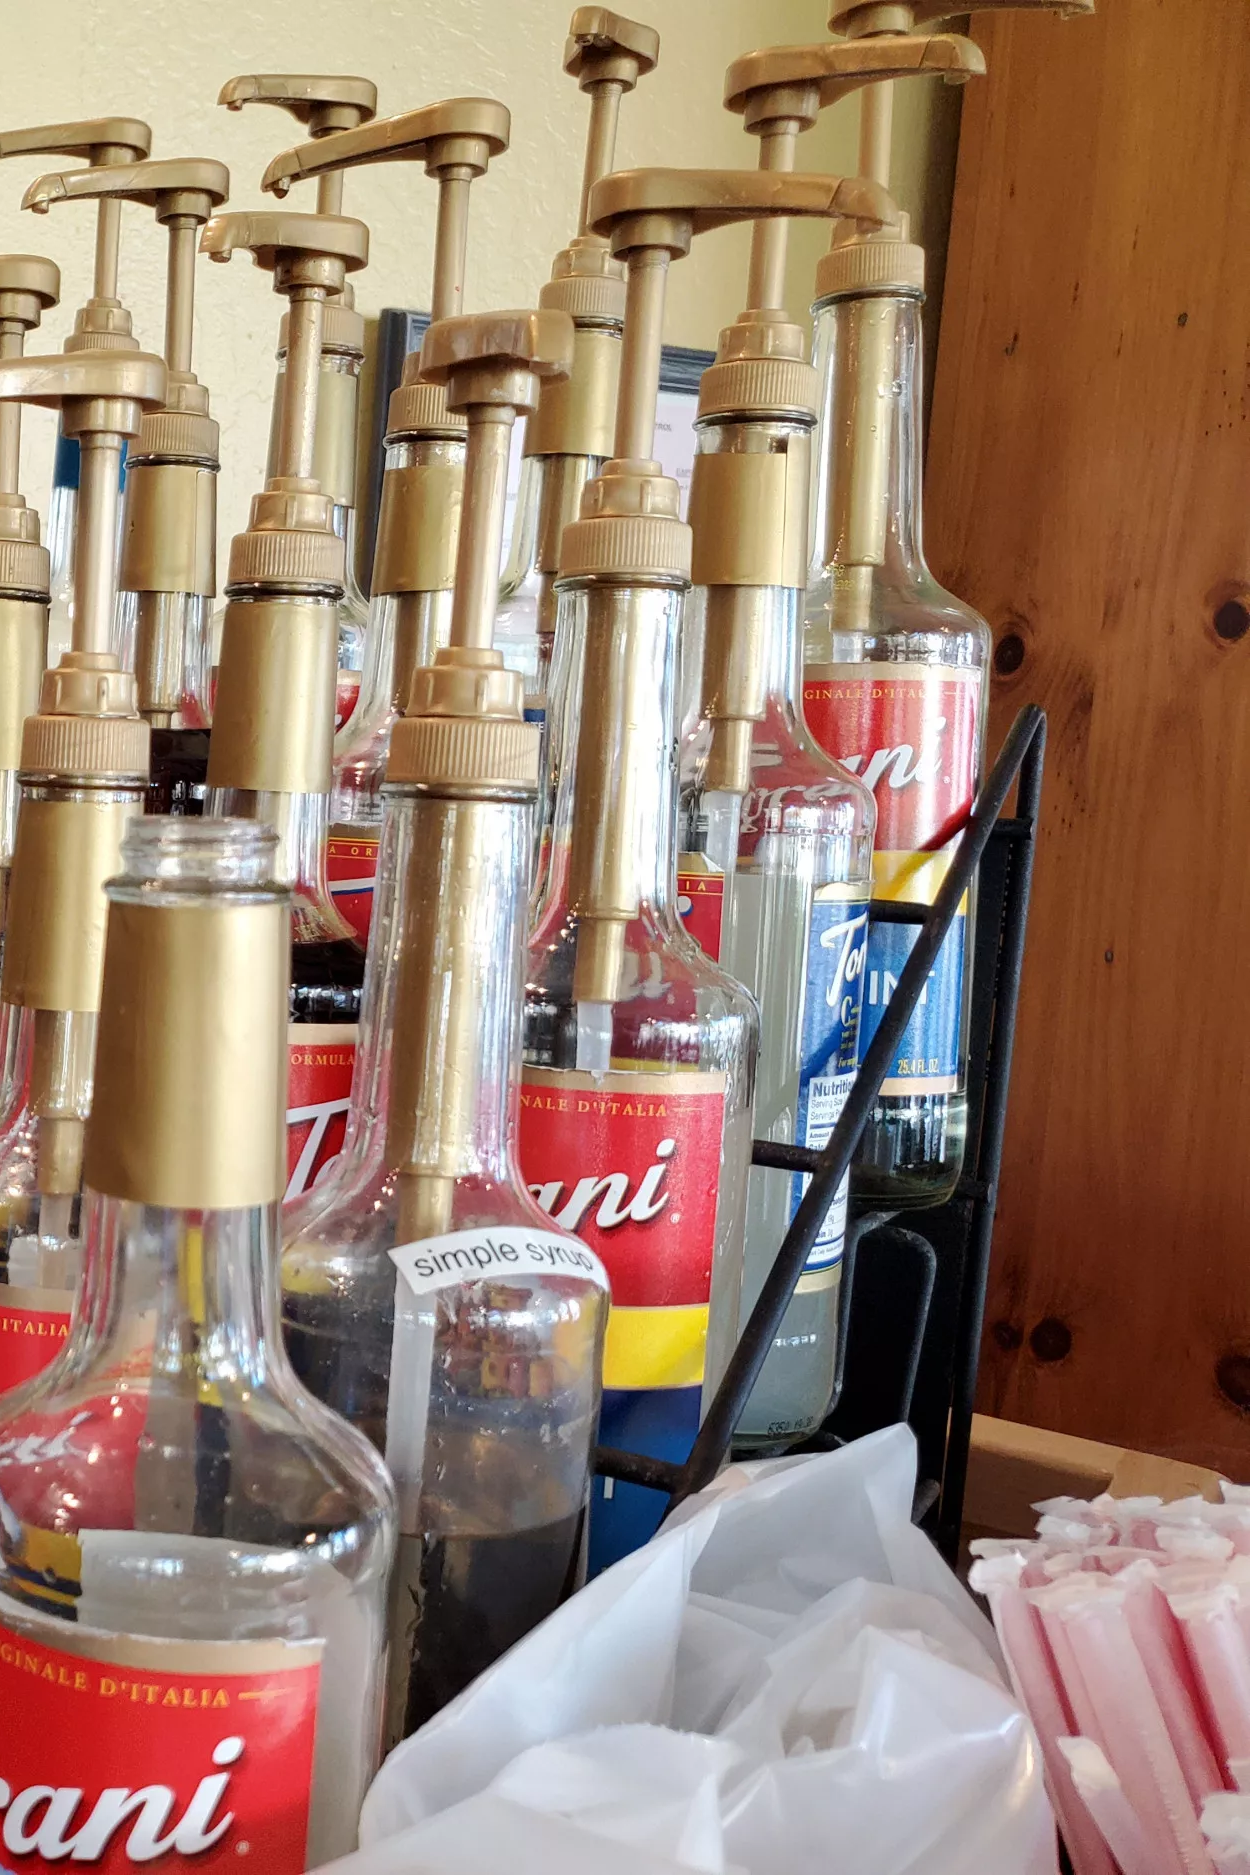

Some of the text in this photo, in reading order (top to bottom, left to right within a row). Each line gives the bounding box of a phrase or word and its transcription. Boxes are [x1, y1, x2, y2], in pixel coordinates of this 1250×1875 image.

[838, 716, 946, 792] ni
[577, 1100, 667, 1117] D'ITALIA
[414, 1238, 594, 1279] simple syrup
[100, 1677, 230, 1709] D'ITALIA
